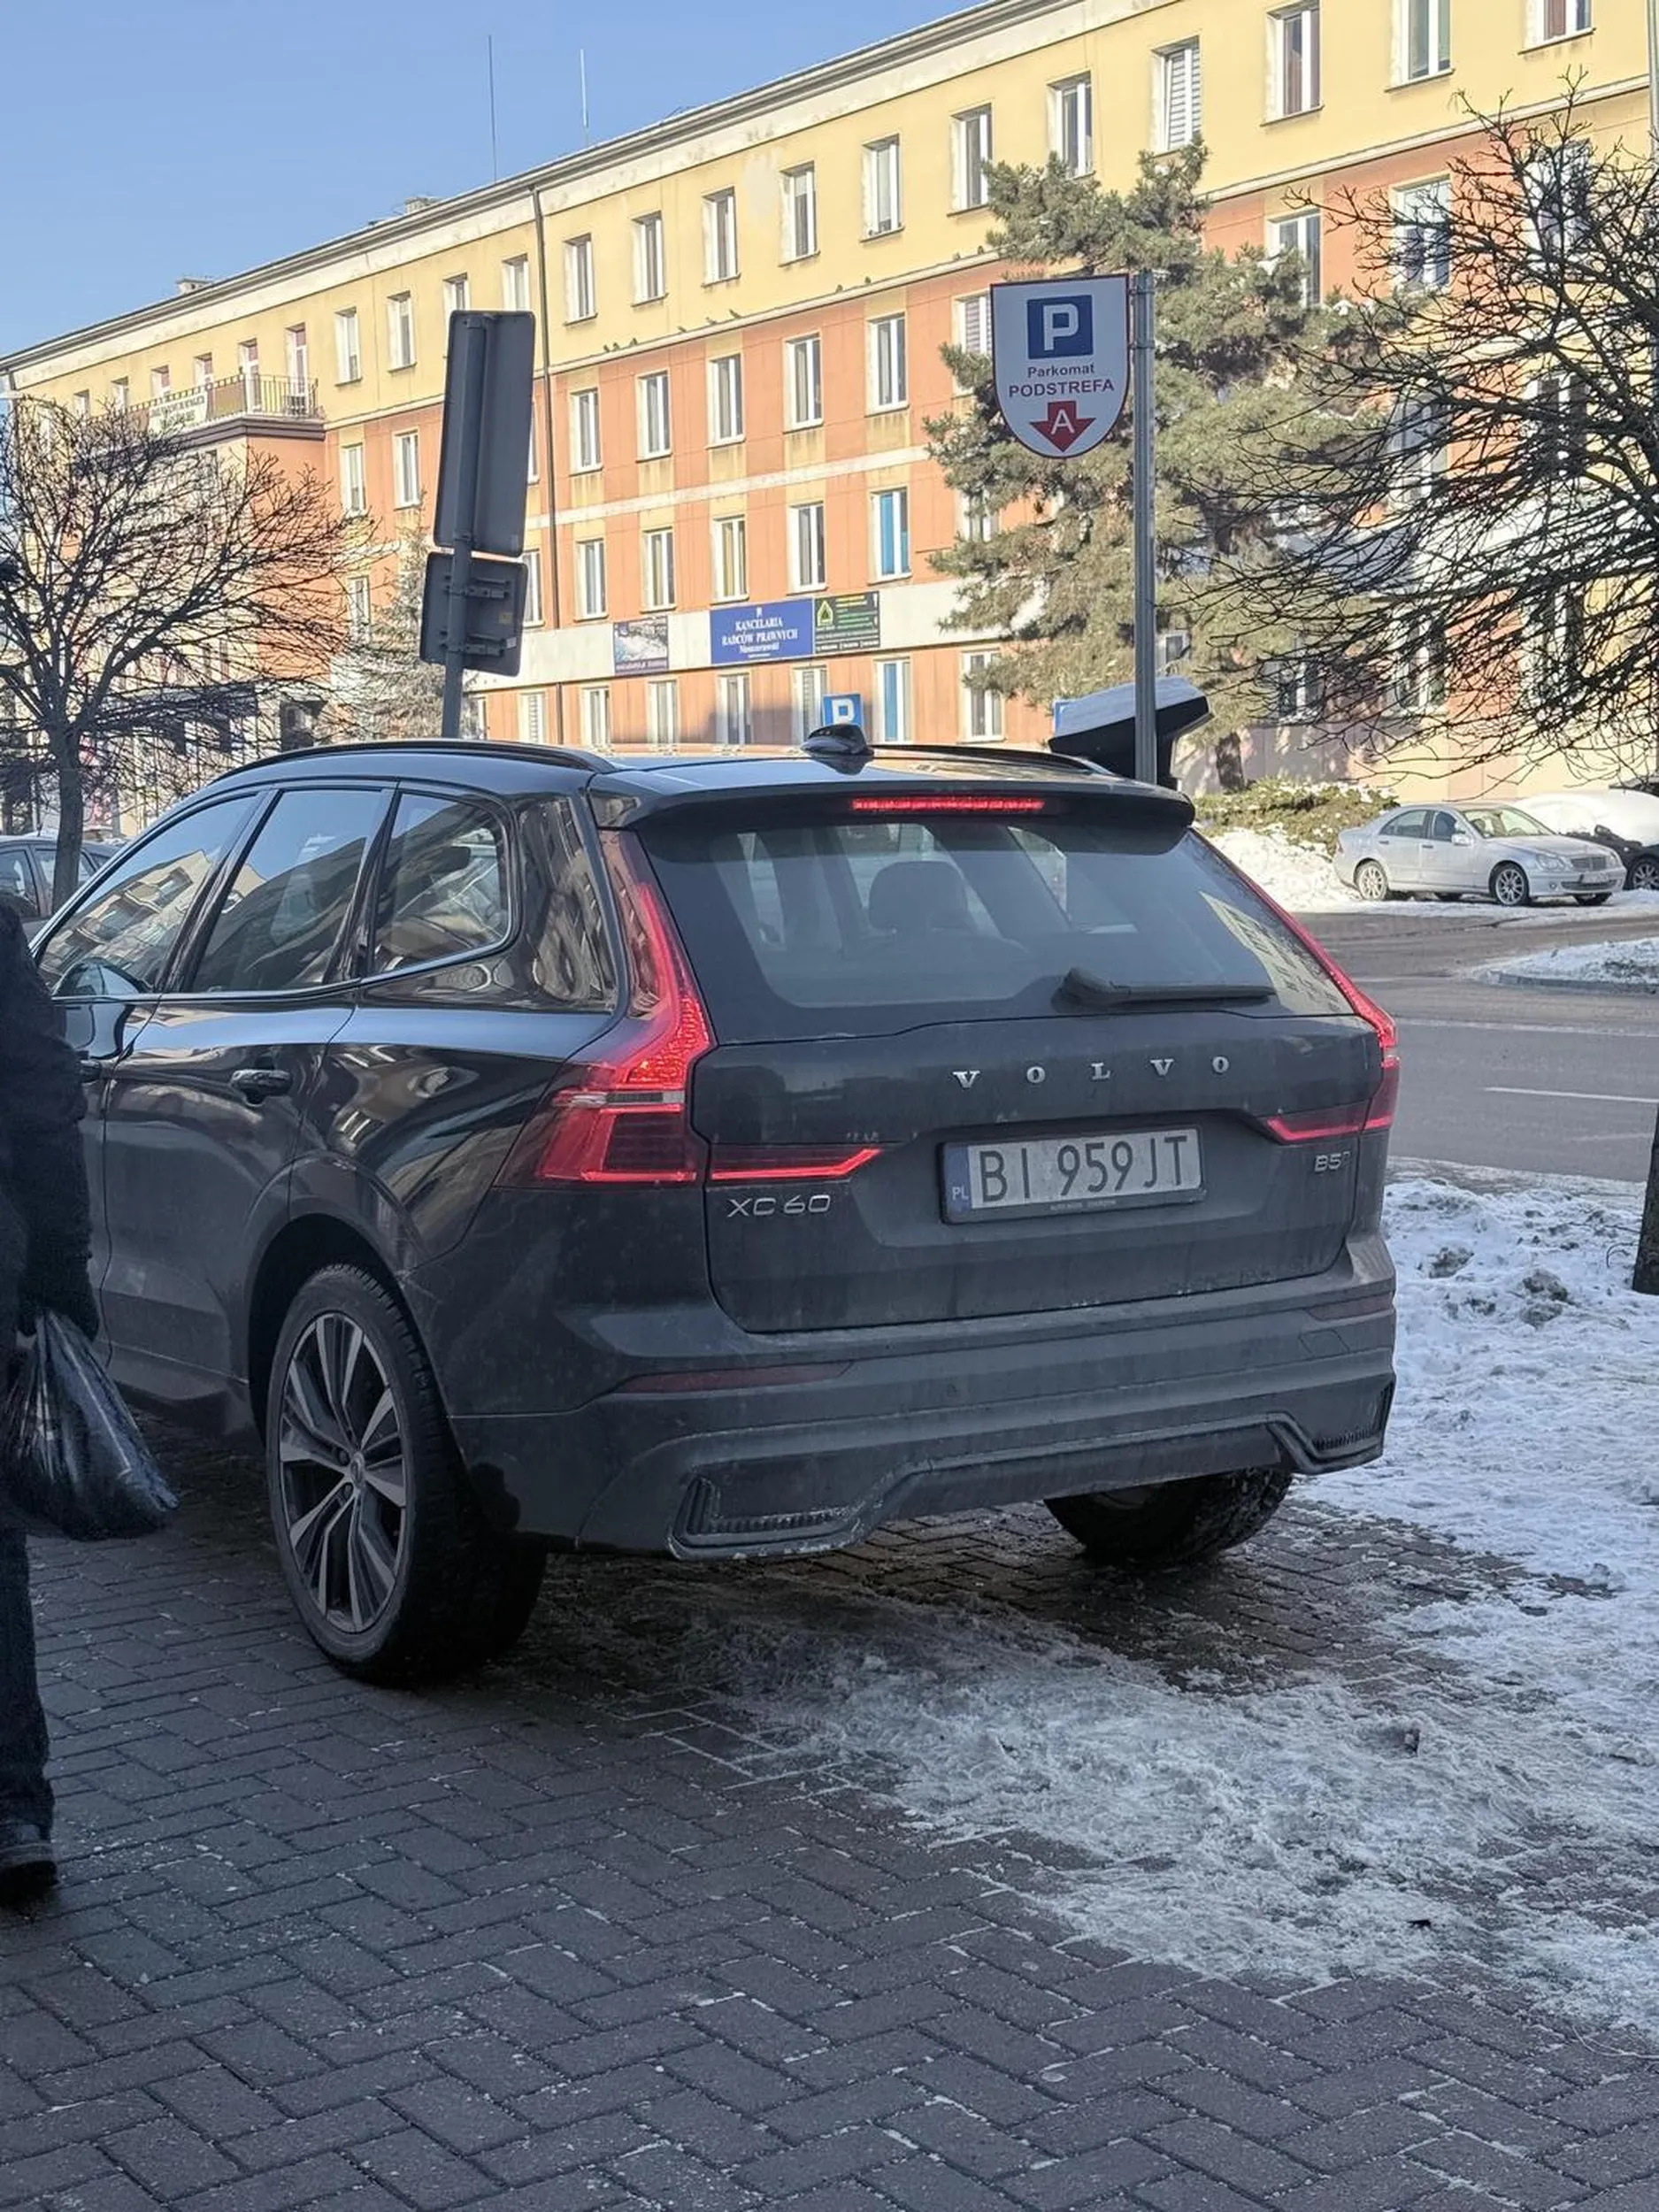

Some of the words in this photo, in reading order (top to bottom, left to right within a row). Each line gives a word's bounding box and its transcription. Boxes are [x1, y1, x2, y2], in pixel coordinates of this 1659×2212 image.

[1043, 303, 1079, 351] P
[1027, 363, 1095, 379] Parkomat
[1009, 379, 1115, 398] PODSTREFA
[1050, 409, 1075, 435] A
[735, 617, 783, 632] KANCELARIA
[952, 1056, 1230, 1089] VOLVO
[979, 1147, 1031, 1203] BI
[1057, 1135, 1187, 1196] 959JT
[951, 1186, 970, 1202] PL
